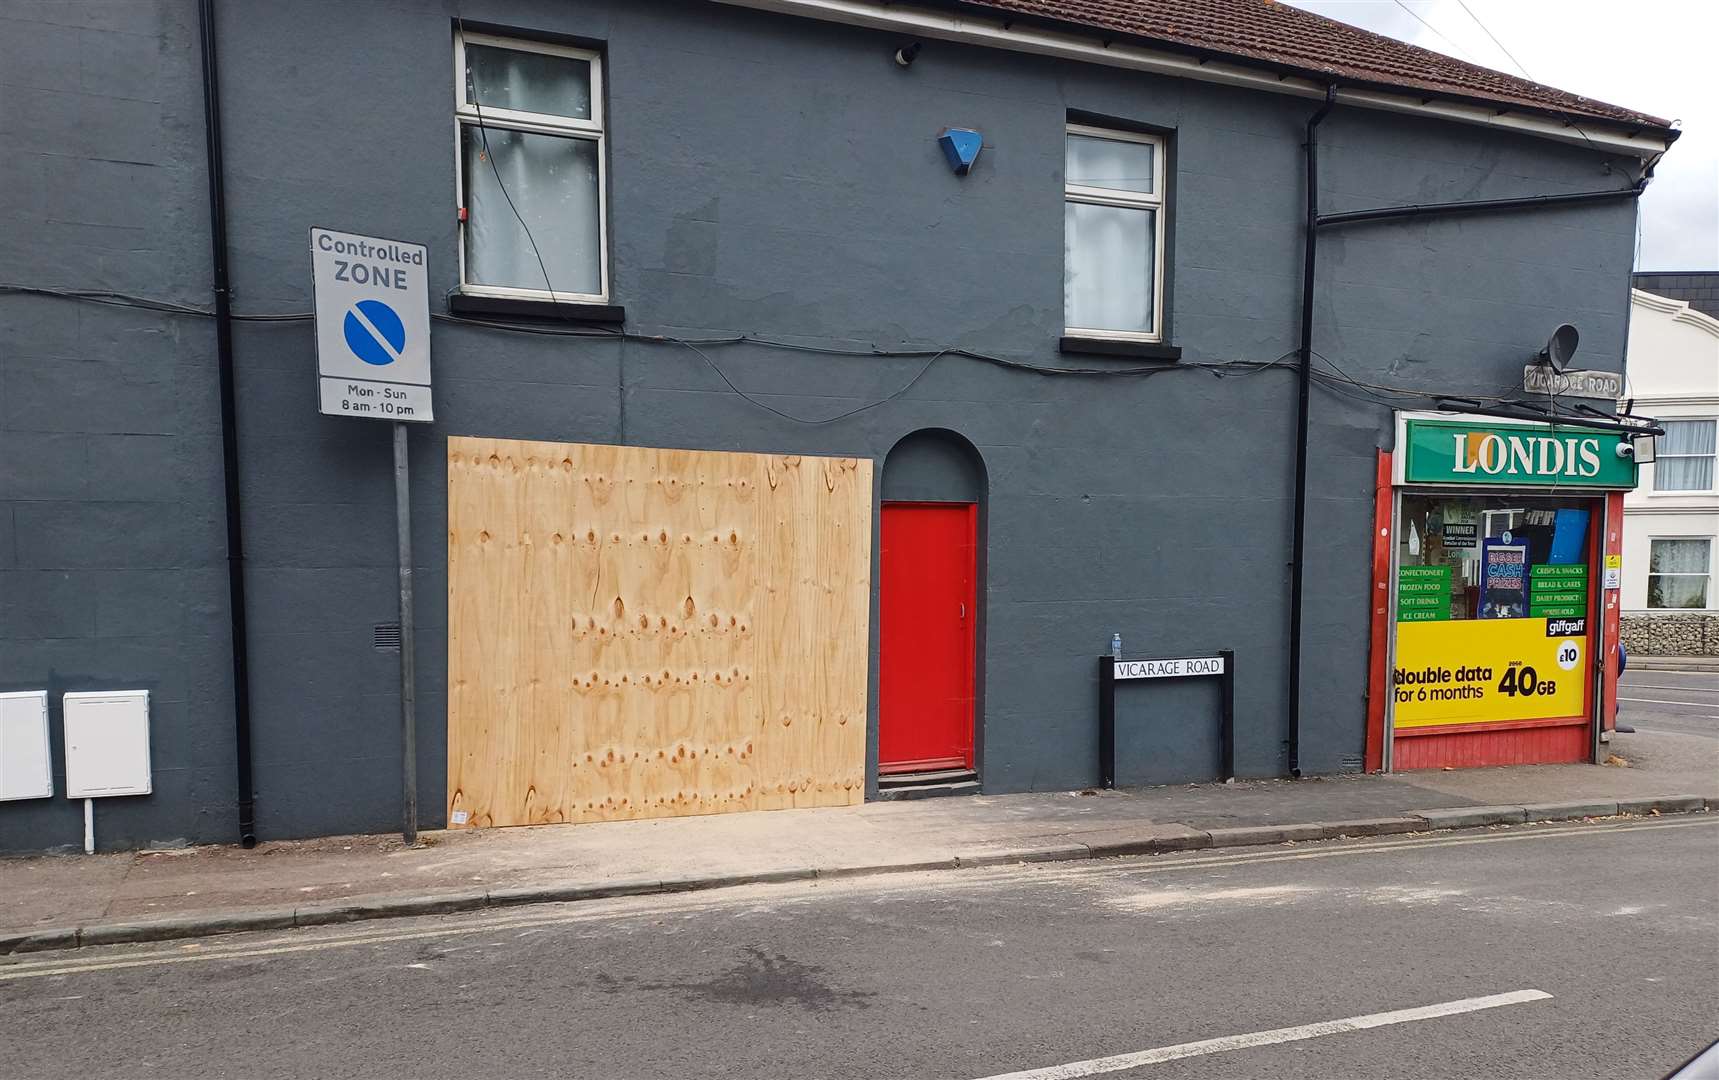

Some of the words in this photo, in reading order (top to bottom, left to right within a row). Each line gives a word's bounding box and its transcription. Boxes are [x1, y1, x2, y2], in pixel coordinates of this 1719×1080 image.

[318, 234, 423, 266] Controlled
[334, 260, 408, 290] ZONE
[348, 385, 374, 397] Mon
[384, 388, 407, 399] Sun
[1588, 376, 1618, 393] ROAD
[342, 400, 349, 410] 8
[352, 402, 370, 411] am
[380, 403, 394, 413] 10
[396, 406, 414, 416] pm
[1452, 433, 1601, 477] LONDIS
[1446, 525, 1474, 535] WINNER
[1488, 563, 1523, 577] CASH
[1400, 583, 1423, 591] FROZEN
[1487, 577, 1522, 588] PRIZES
[1400, 598, 1416, 606] SOFT
[1417, 597, 1440, 605] DRINKS
[1402, 612, 1413, 620] ICE
[1549, 619, 1585, 636] giffgaff
[1559, 648, 1577, 662] £10
[1118, 661, 1180, 677] VICARAGE
[1186, 659, 1220, 674] ROAD
[1393, 666, 1452, 685] double
[1455, 665, 1493, 682] data
[1498, 666, 1556, 697] 40GB
[1394, 687, 1414, 703] for
[1417, 687, 1427, 702] 6
[1430, 684, 1484, 701] months
